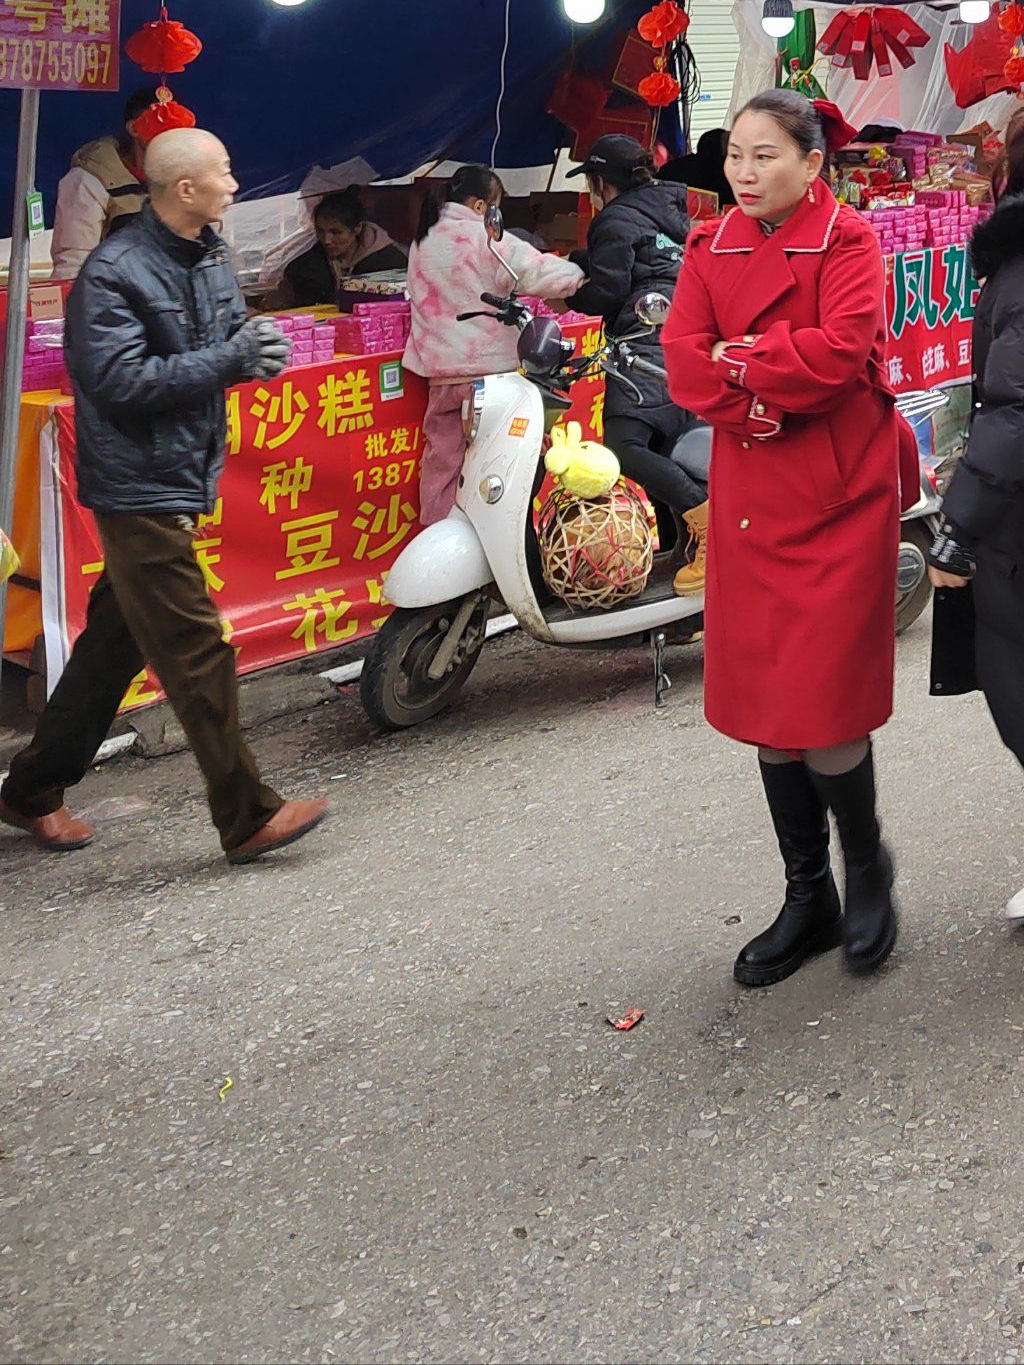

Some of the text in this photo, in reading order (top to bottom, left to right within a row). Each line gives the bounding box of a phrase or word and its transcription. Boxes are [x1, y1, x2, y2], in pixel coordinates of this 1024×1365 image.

[226, 369, 374, 455] 沙糕
[365, 427, 427, 459] 批发/
[352, 459, 421, 493] 1387
